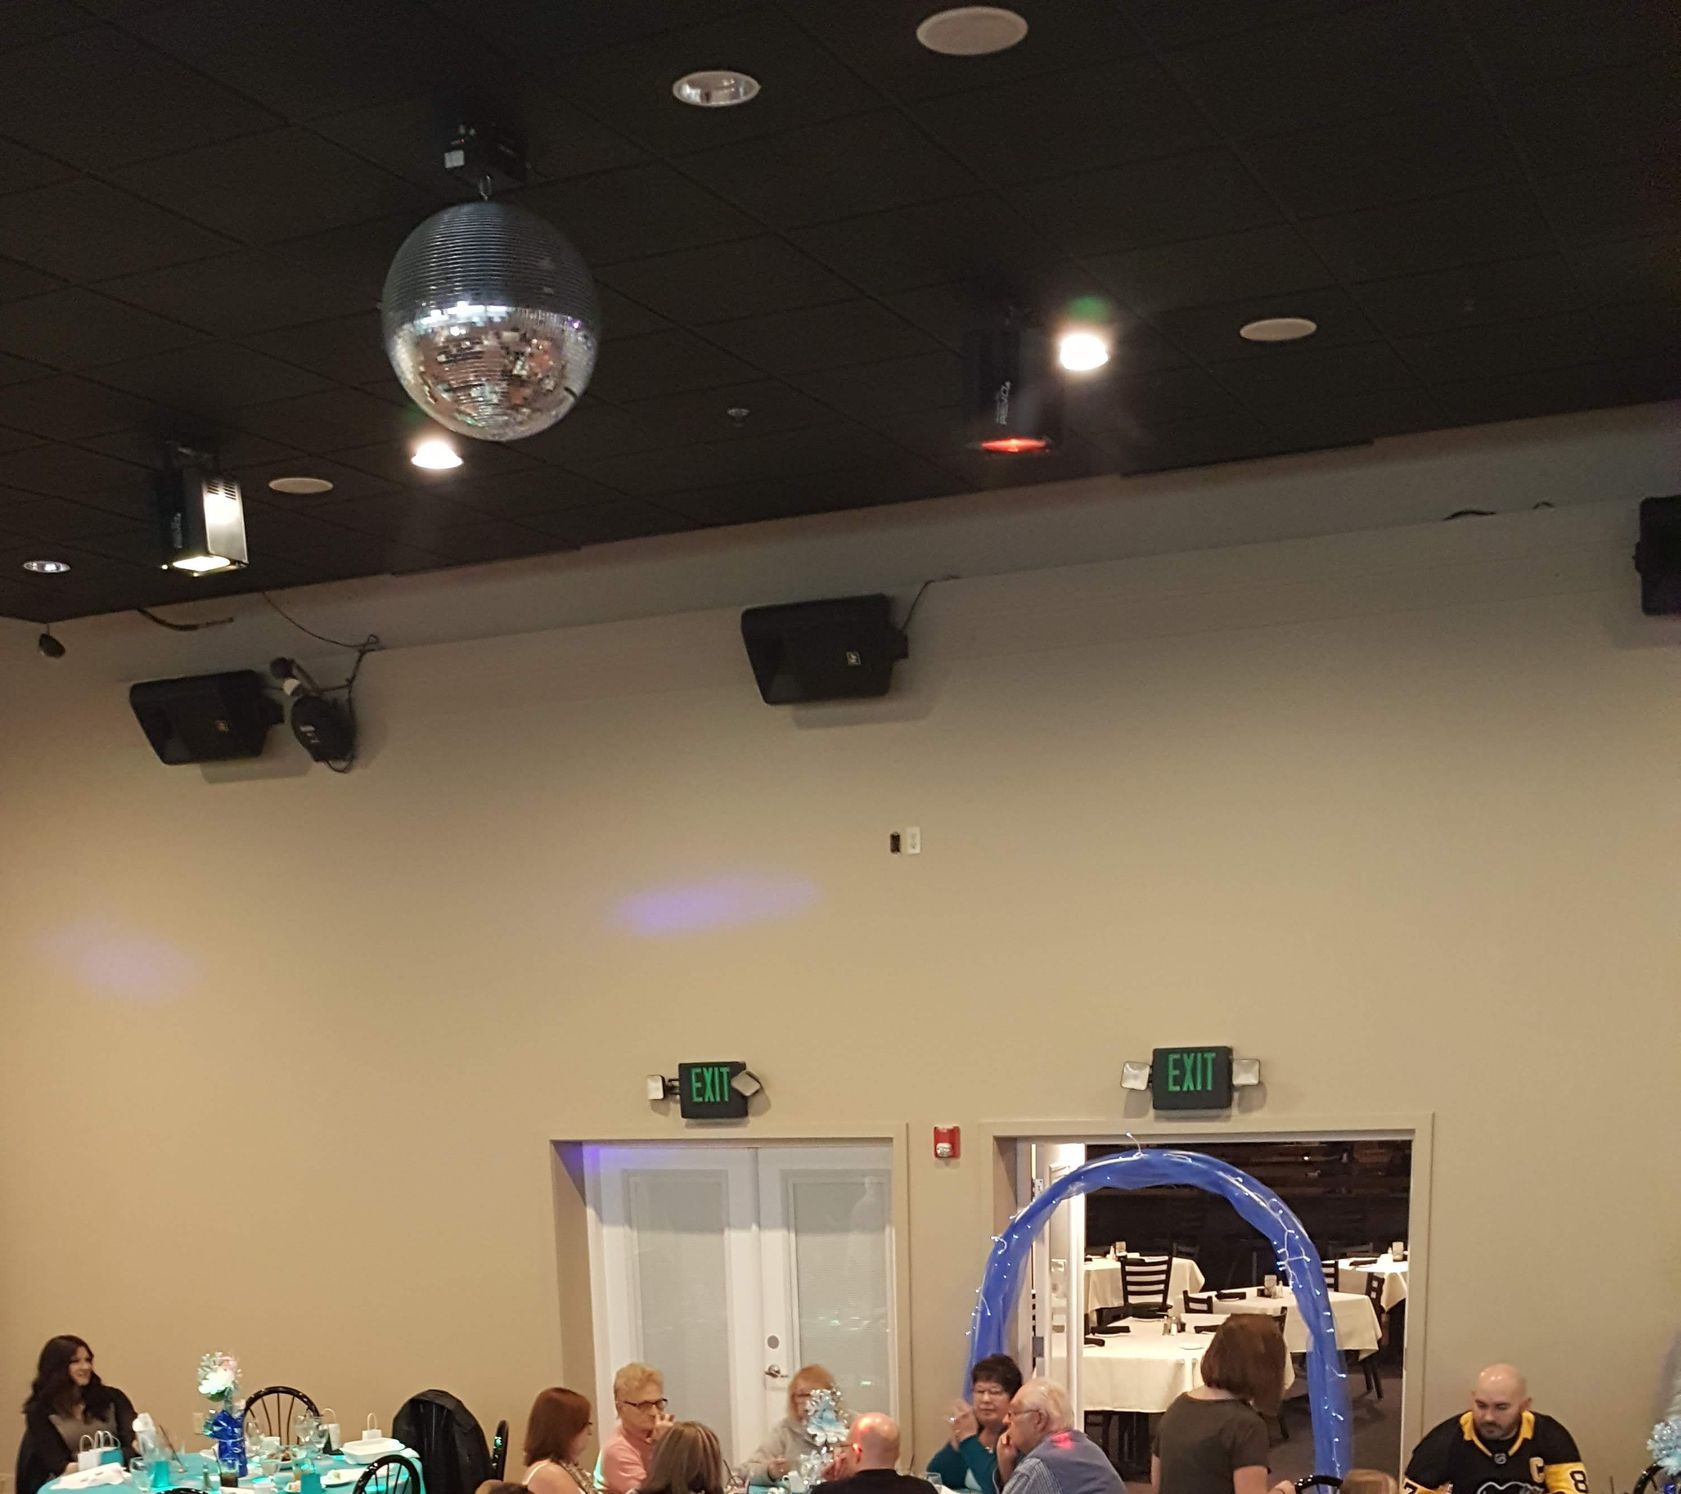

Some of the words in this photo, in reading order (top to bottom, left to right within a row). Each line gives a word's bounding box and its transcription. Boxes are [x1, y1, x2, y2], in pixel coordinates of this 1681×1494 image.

[691, 1066, 730, 1102] EXIT
[1167, 1052, 1216, 1092] EXIT
[1529, 1456, 1546, 1483] C
[1569, 1470, 1589, 1494] 8
